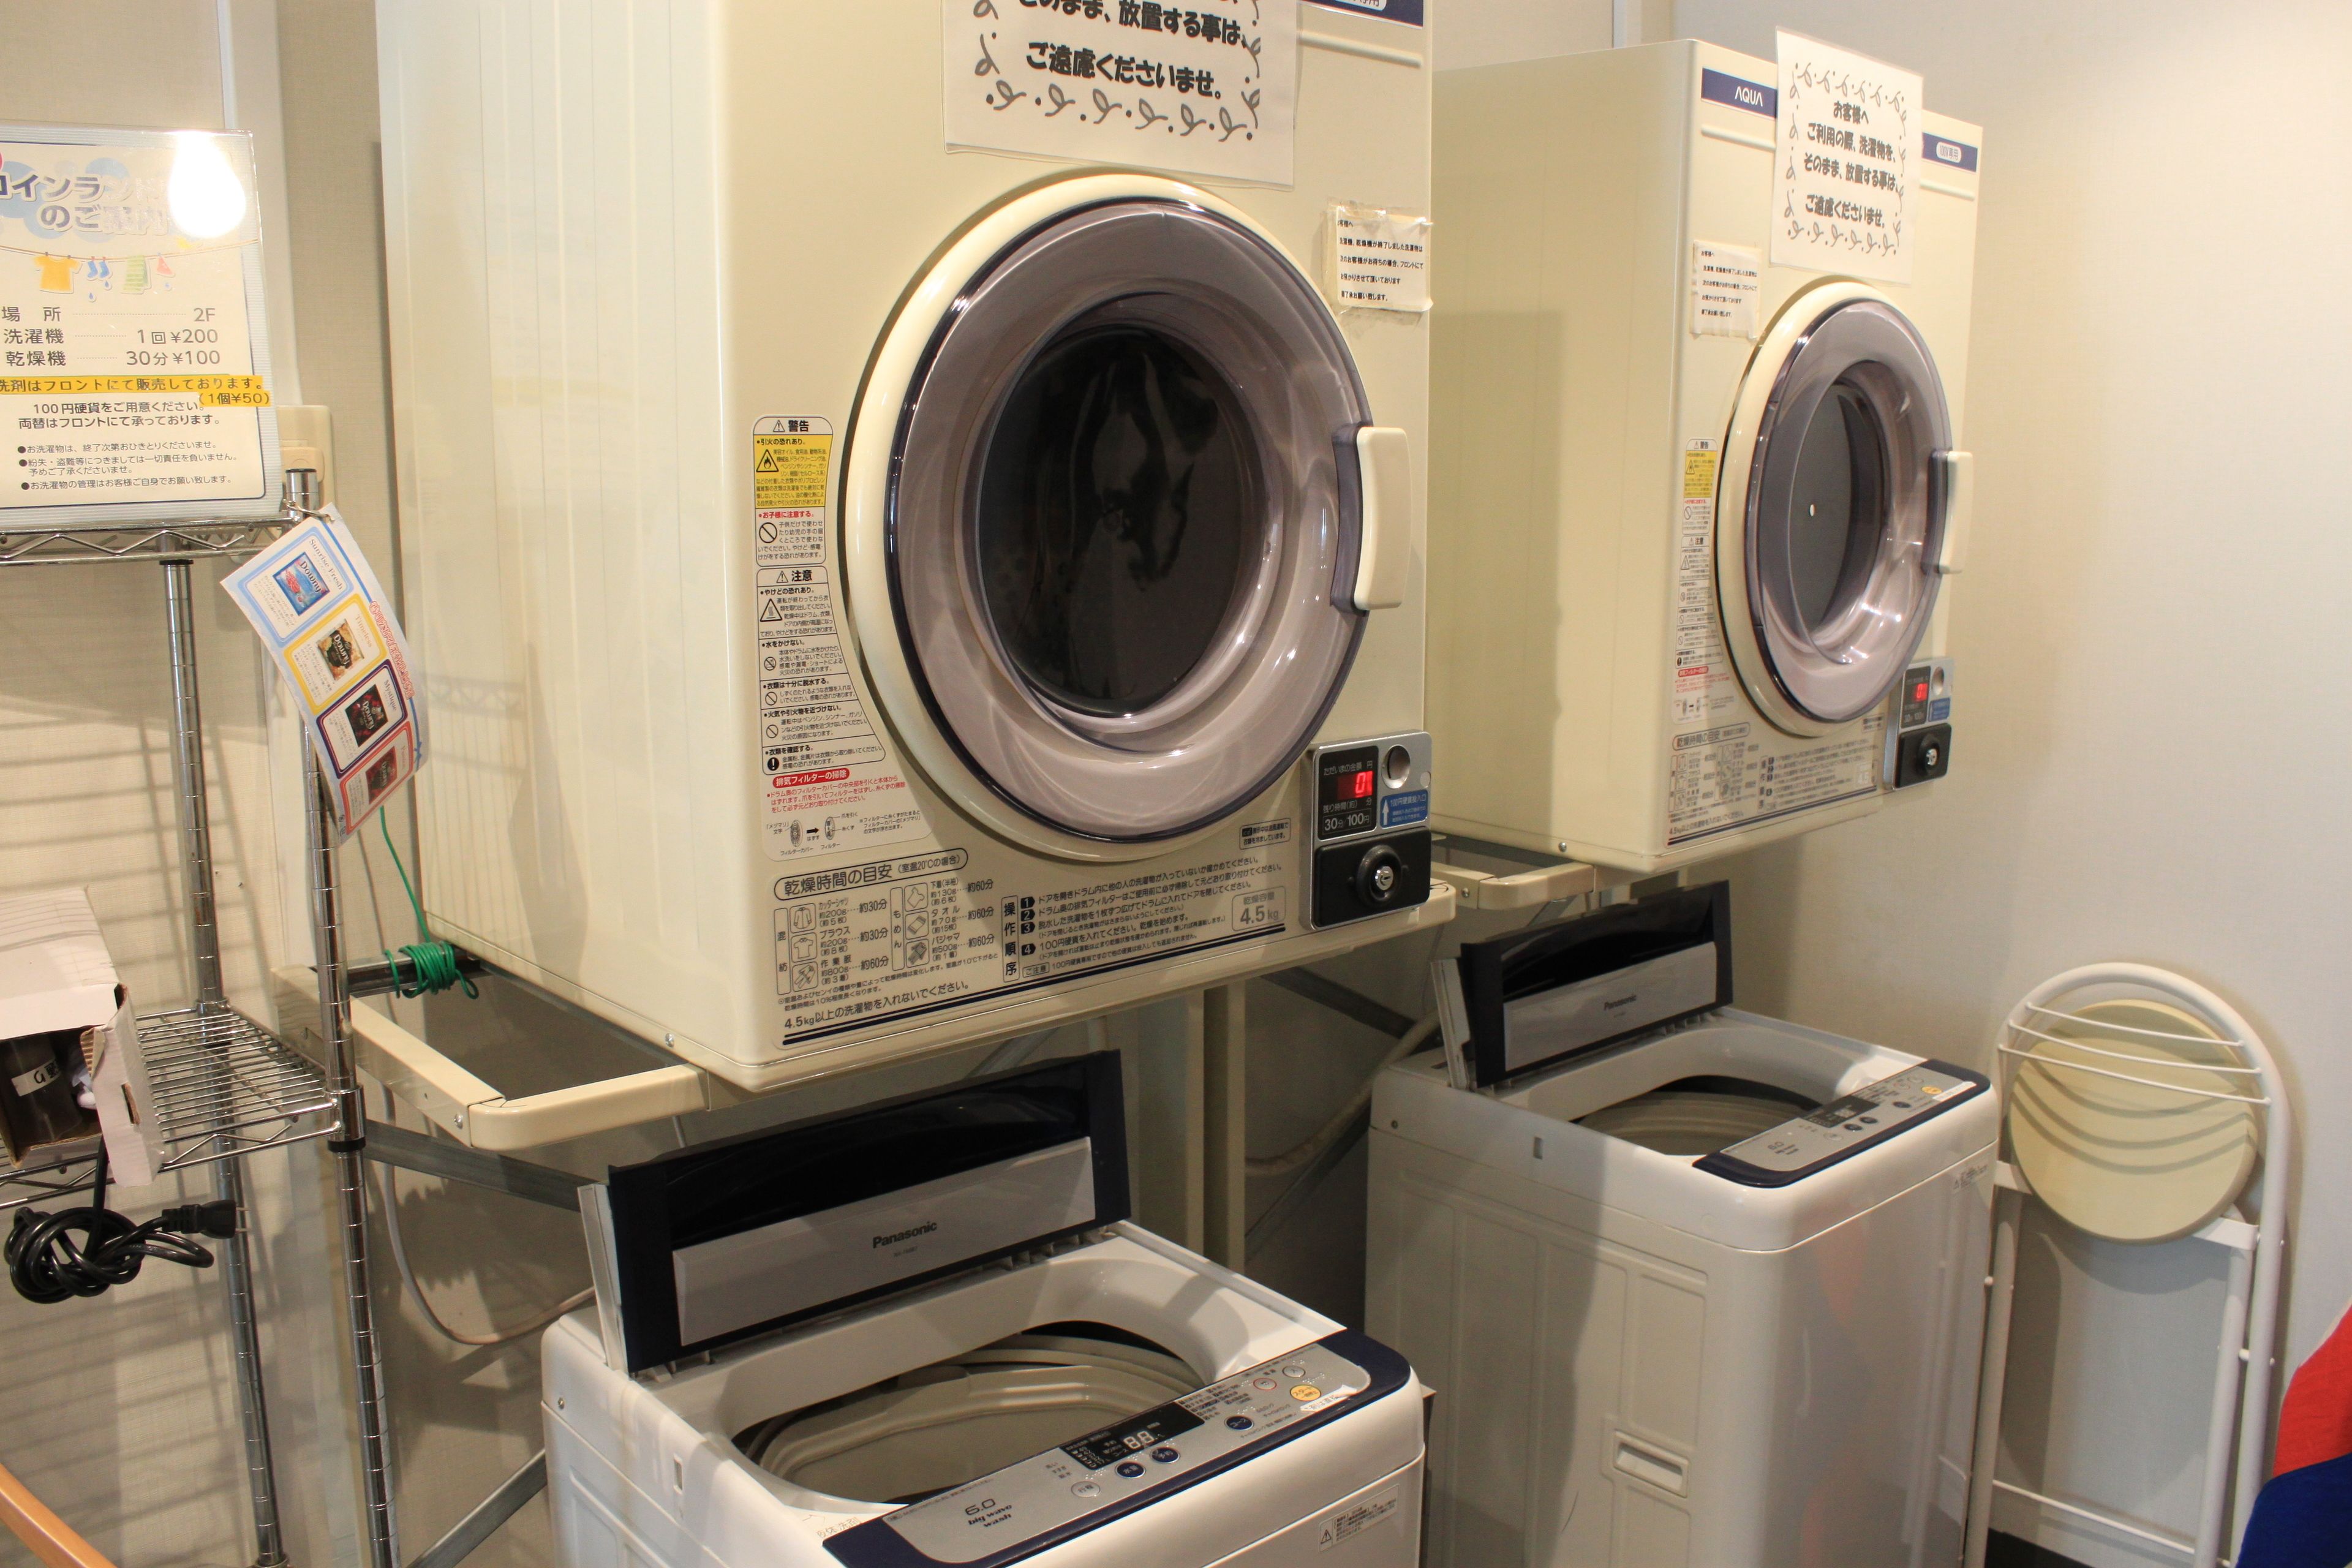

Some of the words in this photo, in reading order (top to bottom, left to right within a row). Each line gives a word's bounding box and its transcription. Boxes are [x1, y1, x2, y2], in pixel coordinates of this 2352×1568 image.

[1026, 42, 1221, 99] ご遠慮くださいませ。
[1735, 86, 1763, 107] AQUA
[1833, 100, 1869, 125] お客様へ
[1806, 123, 1896, 164] ご利用の際、洗濯物を、
[1803, 152, 1899, 193] そのまま、放置する事は、
[1805, 194, 1885, 228] ご遠慮くださいませ。
[194, 307, 216, 322] 2F
[4, 328, 64, 344] 洗濯機
[6, 350, 66, 366] 乾燥機
[0, 377, 263, 392] 洗剤はフロントにて販売しております。
[34, 401, 205, 415] 100円硬貨をご用意ください。
[18, 414, 220, 429] 両替はフロントにて承っております。
[788, 420, 809, 432] 警告
[27, 441, 217, 454] お洗濯物は、終了次第おひきとりくださいませ。
[28, 453, 236, 467] 紛失・盗難等につきましては一切責任を負いません。
[29, 466, 133, 477] 予めご了承くださいませ。
[31, 475, 232, 490] お洗濯物の管理はお客様ご自身でお願い致します。
[763, 510, 814, 519] お子様に注意する。
[309, 539, 330, 567] Sunrise
[328, 568, 342, 590] Fresh
[300, 560, 322, 593] Downy
[791, 570, 812, 582] 注意
[764, 587, 814, 596] やけどの恐れあり。
[356, 614, 372, 648] Timeless
[333, 633, 350, 666] Downy
[766, 639, 804, 648] 水をかけない。
[767, 677, 829, 690] 衣類は十分に脱水する。
[383, 679, 398, 712] Mystique
[362, 699, 375, 731] Downy
[767, 705, 842, 718] 火気や引火物を近づけない。
[769, 744, 813, 756] 衣類を確認する。
[775, 769, 848, 787] 排気フィルターの掃除
[1366, 797, 1373, 806] 分
[780, 846, 814, 856] フィルターカバー
[784, 864, 892, 897] 乾燥時間の目安
[967, 878, 993, 894] 約60分
[859, 899, 888, 914] 約30分
[1243, 892, 1275, 905] 乾燥容量
[931, 905, 960, 918] タオル
[967, 906, 995, 921] 約60分
[1240, 905, 1265, 924] 4.5
[1267, 909, 1279, 921] kg
[820, 925, 851, 940] ブラウス
[860, 927, 888, 943] 約30分
[932, 932, 961, 946] パジャマ
[968, 933, 995, 949] 約60分
[861, 956, 889, 971] 約60分
[785, 980, 970, 1029] 4.5kg以上の洗濯物を入れないでください。
[872, 1221, 938, 1249] Panasonic
[965, 1498, 996, 1516] 6.0
[968, 1514, 986, 1526] big
[986, 1504, 1012, 1517] wave
[983, 1513, 1012, 1528] wash
